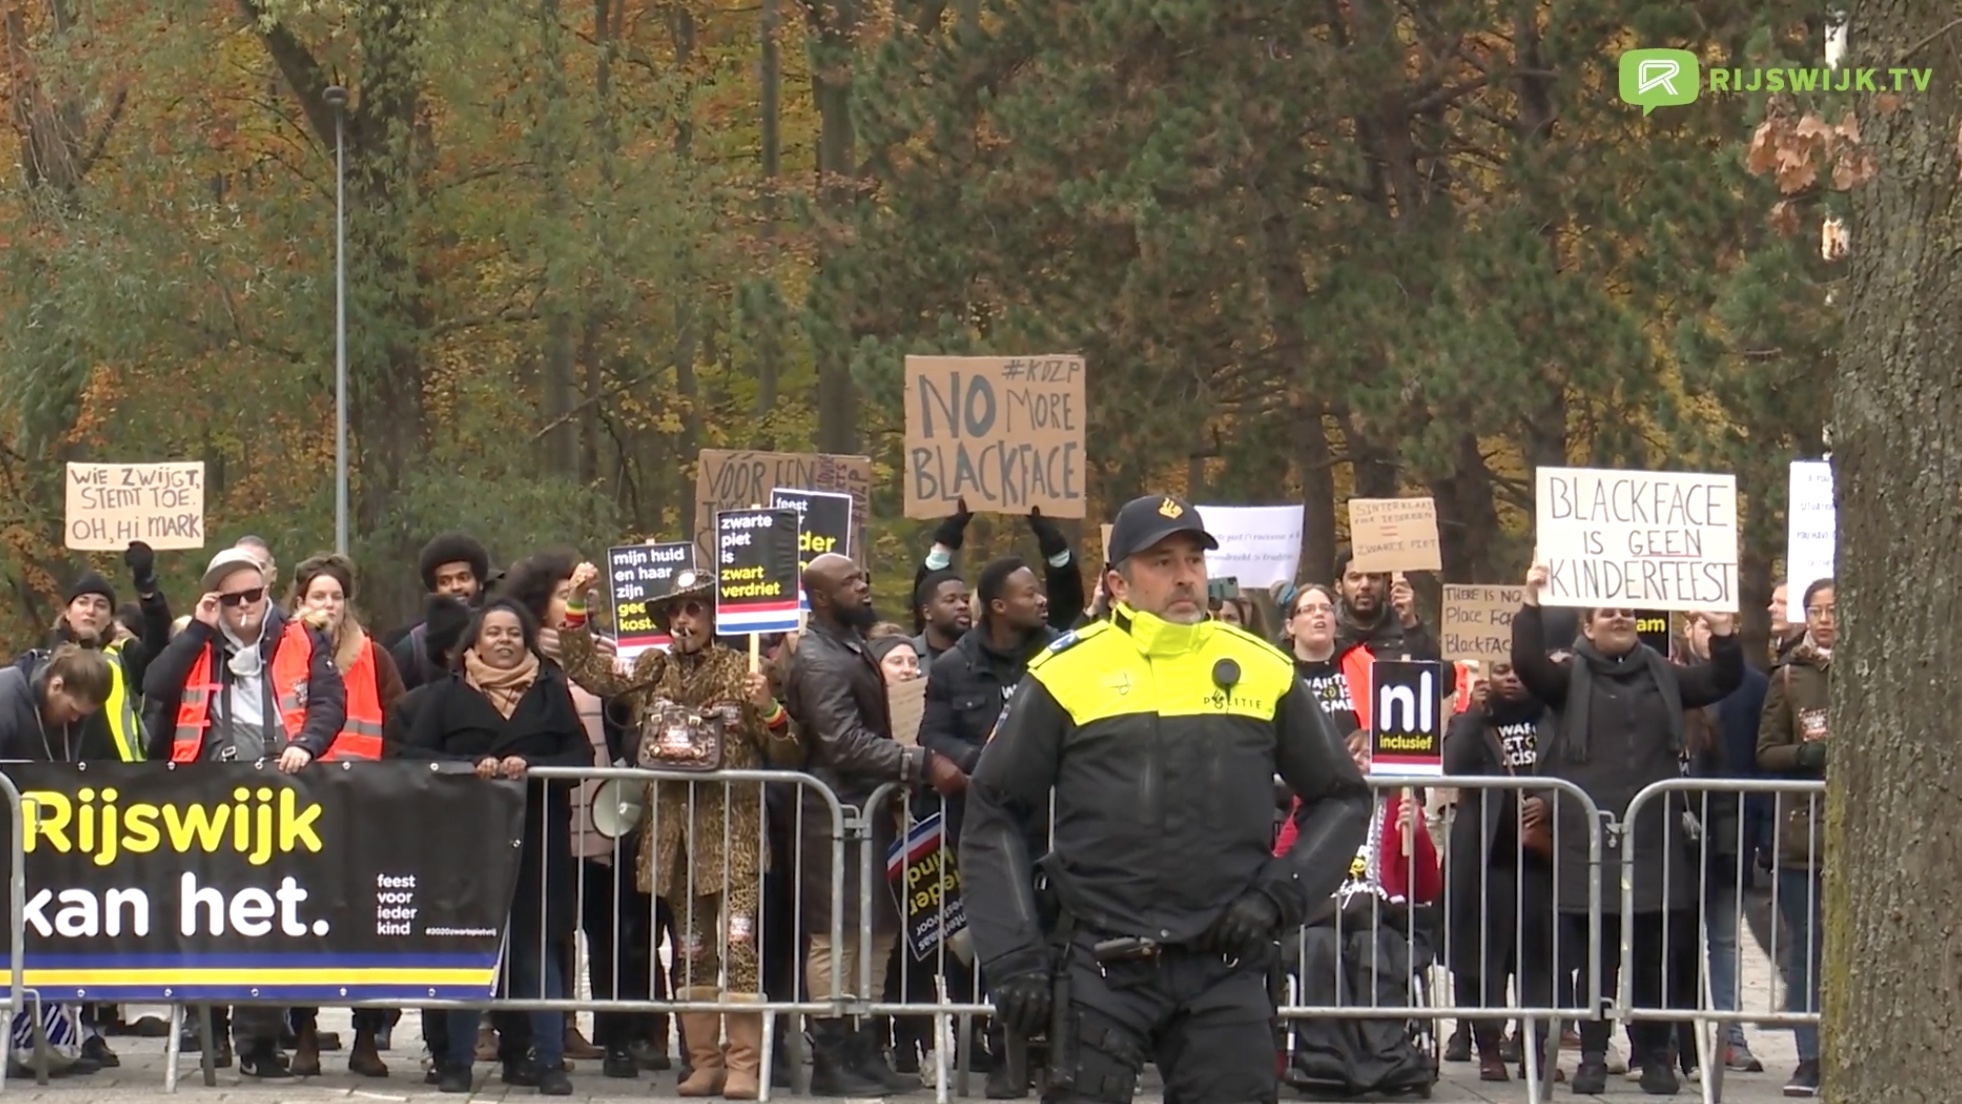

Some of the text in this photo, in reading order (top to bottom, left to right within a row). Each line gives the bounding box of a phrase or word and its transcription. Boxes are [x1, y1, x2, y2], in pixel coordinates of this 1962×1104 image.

[918, 371, 1075, 438] NO MORE
[704, 453, 766, 503] VÓÓR
[912, 440, 1079, 507] BLACKFACE
[149, 487, 197, 508] TOE.
[776, 496, 808, 511] feest
[1550, 477, 1729, 527] BLACKFACE
[148, 513, 201, 538] MARK
[721, 514, 773, 530] zwarte
[721, 532, 751, 549] piet
[799, 530, 837, 552] der
[1411, 539, 1436, 549] PIET
[1583, 529, 1702, 556] IS GEEN
[613, 547, 685, 566] mijn huid
[721, 550, 735, 564] is
[614, 567, 673, 581] en haar
[721, 566, 764, 580] zwart
[1550, 559, 1737, 603] KINDERFEEST
[616, 584, 644, 600] zijn
[721, 581, 780, 598] verdriet
[1444, 587, 1523, 603] THERE IS NO
[618, 603, 646, 617] gee
[1445, 634, 1512, 655] BlackFAC
[1380, 670, 1432, 733] nl
[1379, 734, 1433, 750] inclusief
[21, 787, 323, 866] Rijswijk
[377, 873, 416, 888] feest
[180, 872, 330, 937] het.
[377, 892, 414, 904] voor
[377, 905, 418, 919] ieder
[377, 921, 411, 935] kind
